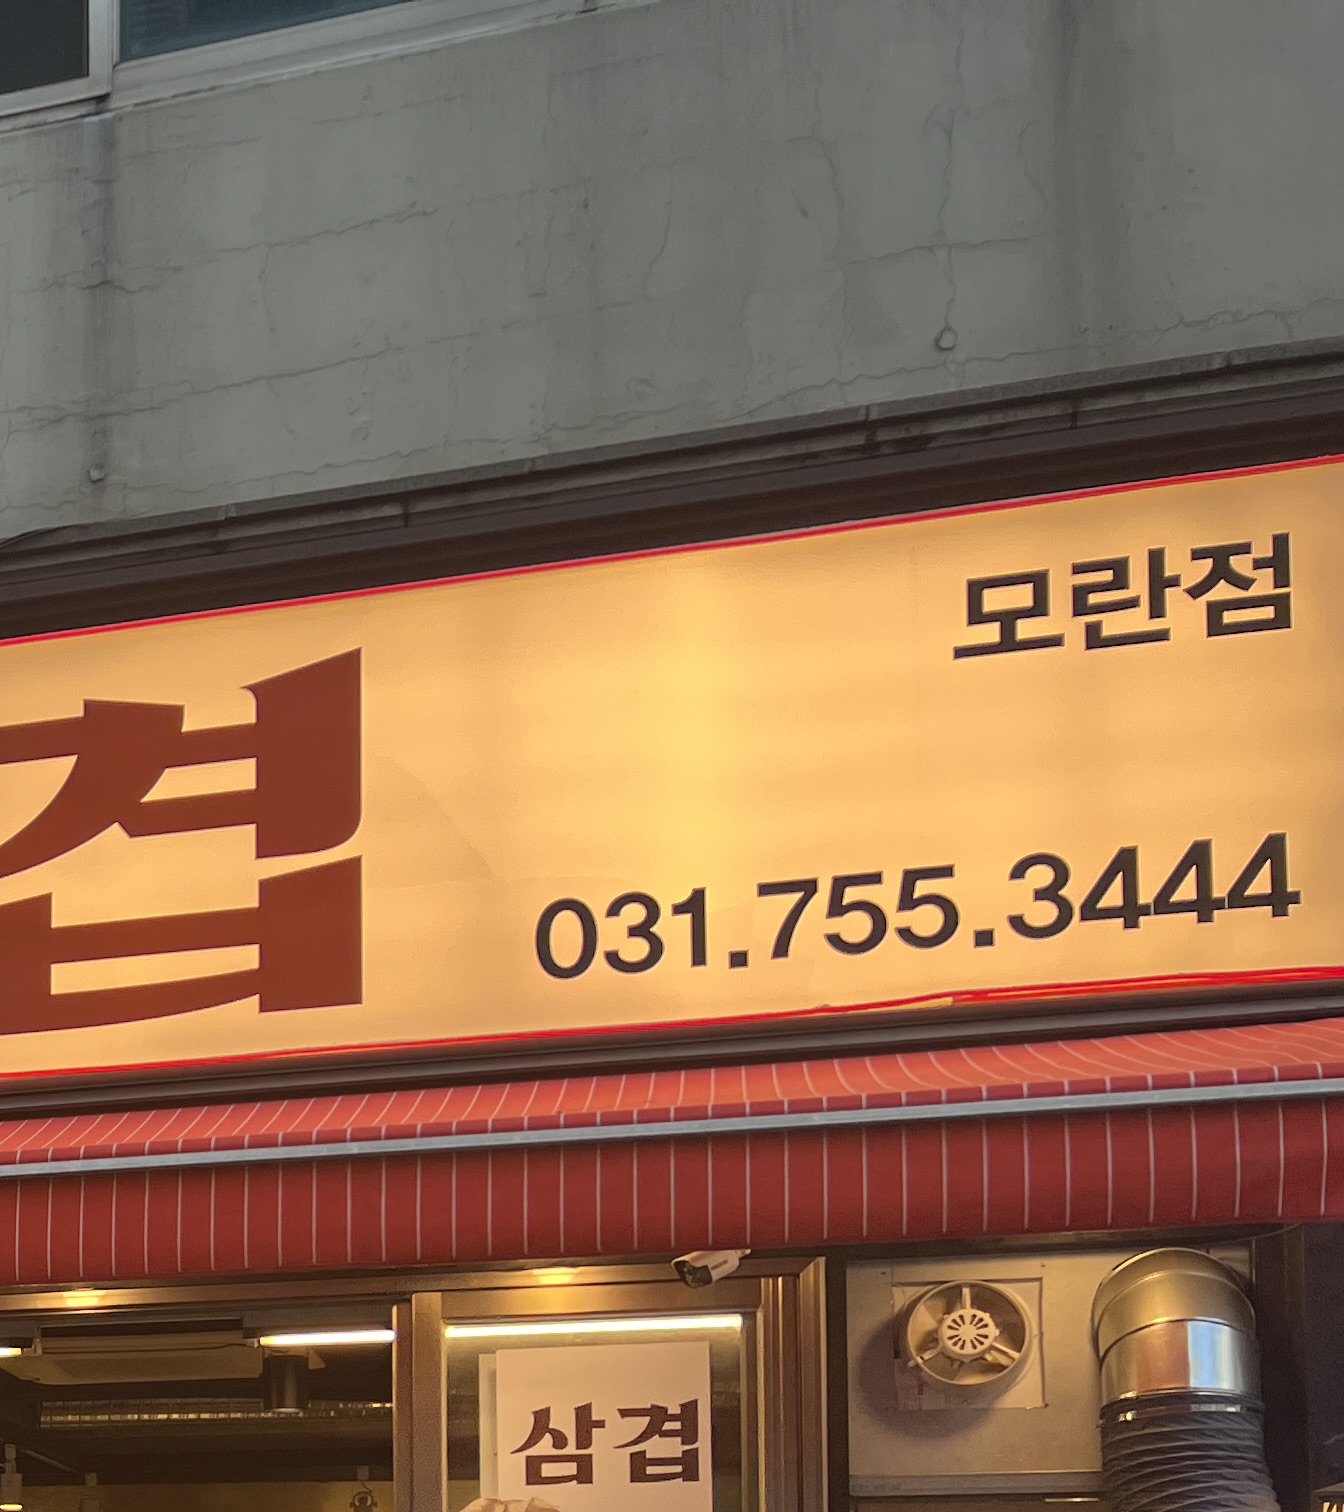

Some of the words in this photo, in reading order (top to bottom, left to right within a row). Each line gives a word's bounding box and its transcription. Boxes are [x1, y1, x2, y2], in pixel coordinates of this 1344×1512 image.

[953, 532, 1292, 660] 모란점
[535, 833, 1301, 979] 031.755.3444
[510, 1398, 700, 1486] 삼겹
